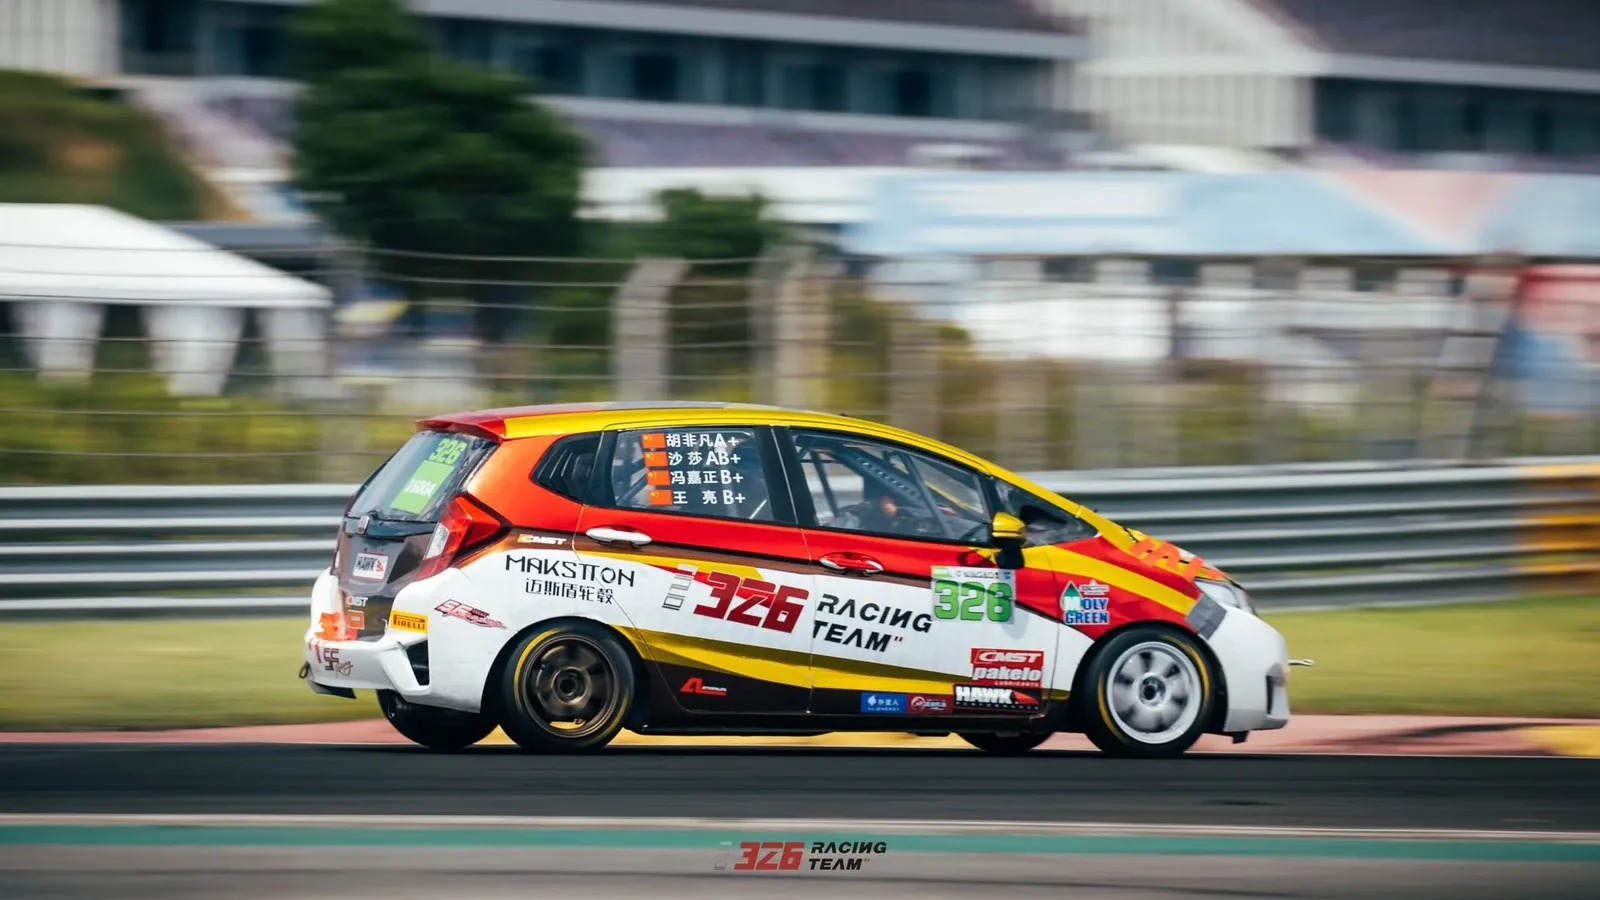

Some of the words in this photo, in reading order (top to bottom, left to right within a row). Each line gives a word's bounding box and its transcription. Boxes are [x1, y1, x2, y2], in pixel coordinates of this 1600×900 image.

[666, 433, 713, 448] 胡非凡
[714, 433, 739, 448] A+
[428, 438, 468, 465] 326
[705, 450, 741, 466] AB+
[670, 469, 718, 485] 冯嘉正
[720, 469, 744, 485] B+
[722, 489, 746, 505] B+
[692, 570, 810, 634] 326
[933, 579, 1013, 623] 326
[816, 593, 933, 634] RACING
[1064, 610, 1108, 625] GREEN
[392, 613, 426, 631] PIRELLI
[976, 651, 1042, 664] CMST
[972, 666, 1042, 682] pakelo
[955, 686, 1013, 705] HAWK
